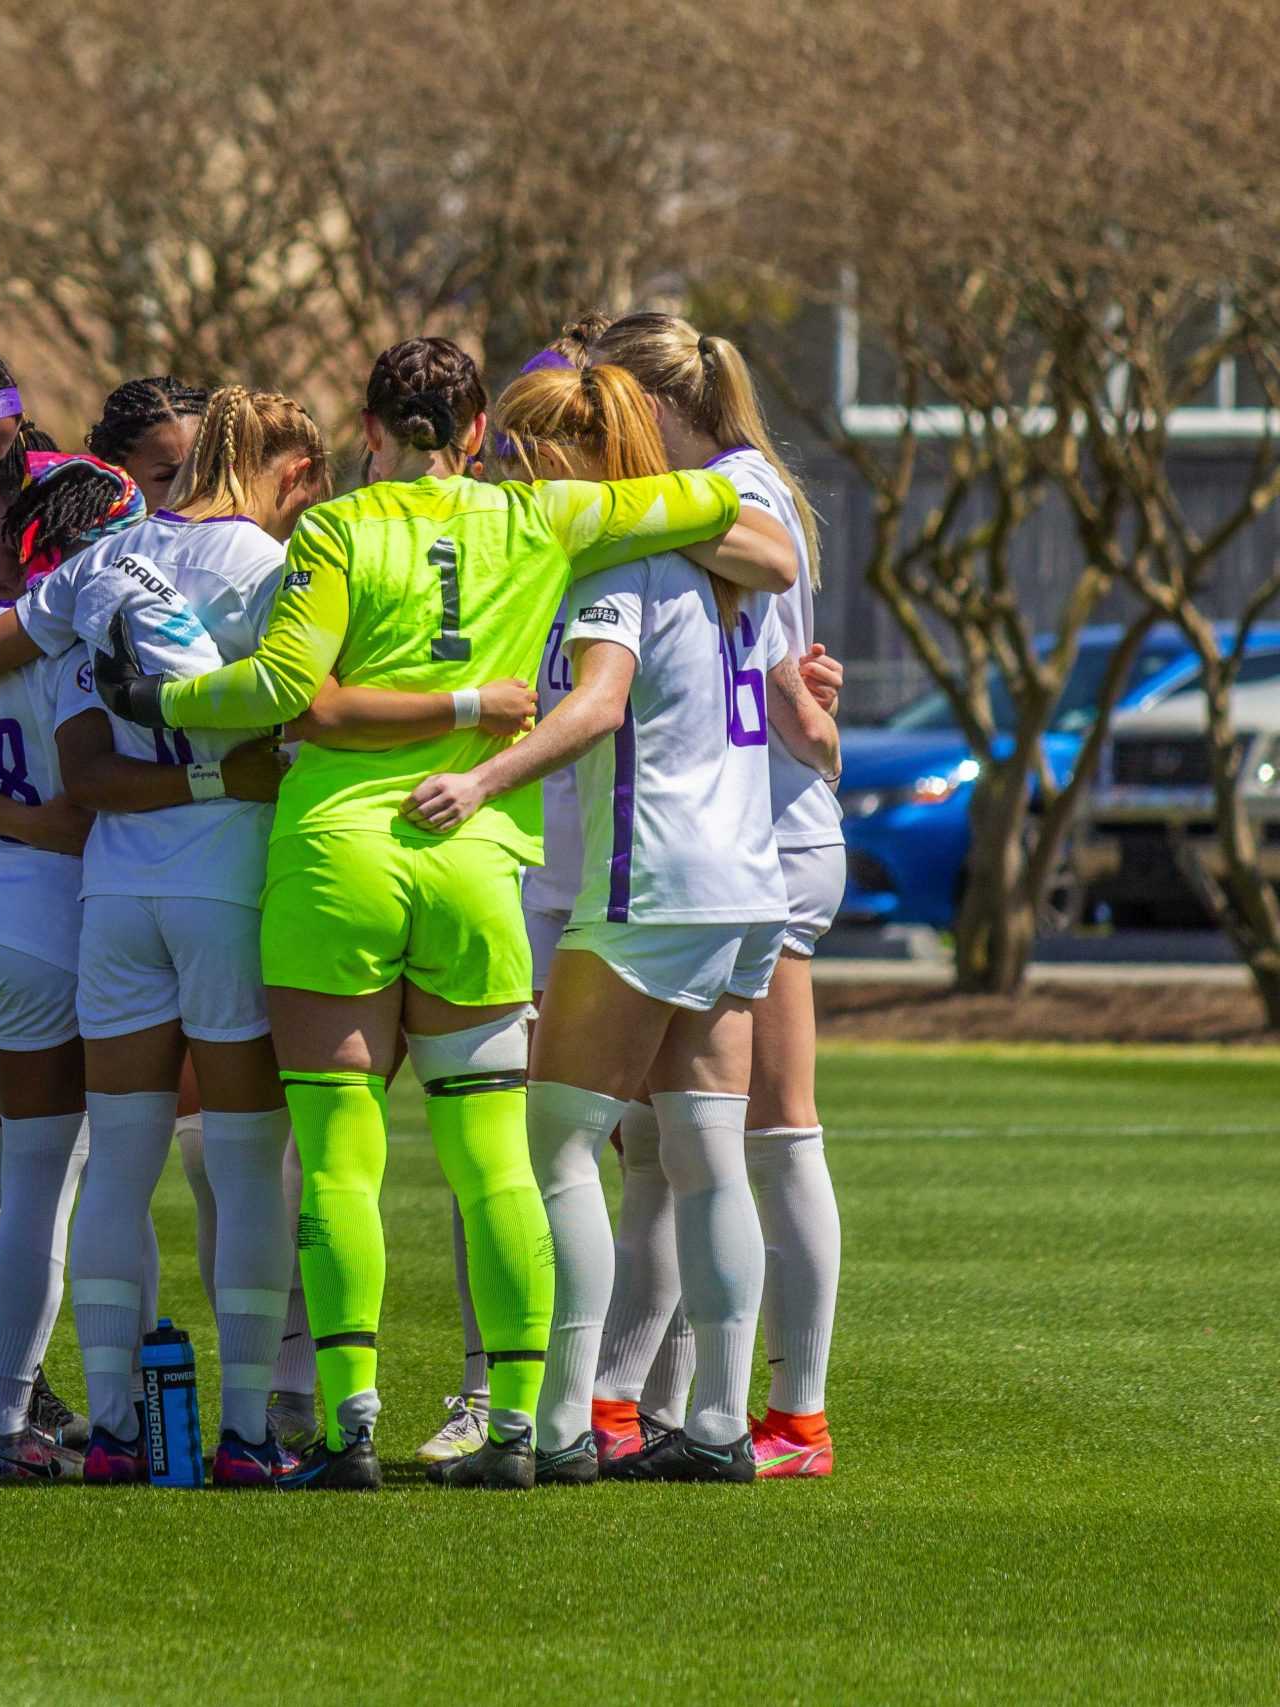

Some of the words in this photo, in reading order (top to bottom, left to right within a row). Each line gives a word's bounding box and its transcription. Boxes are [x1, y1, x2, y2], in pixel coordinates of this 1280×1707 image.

[112, 556, 177, 606] RADE
[428, 538, 471, 661] 1
[146, 1369, 166, 1472] POWERADE
